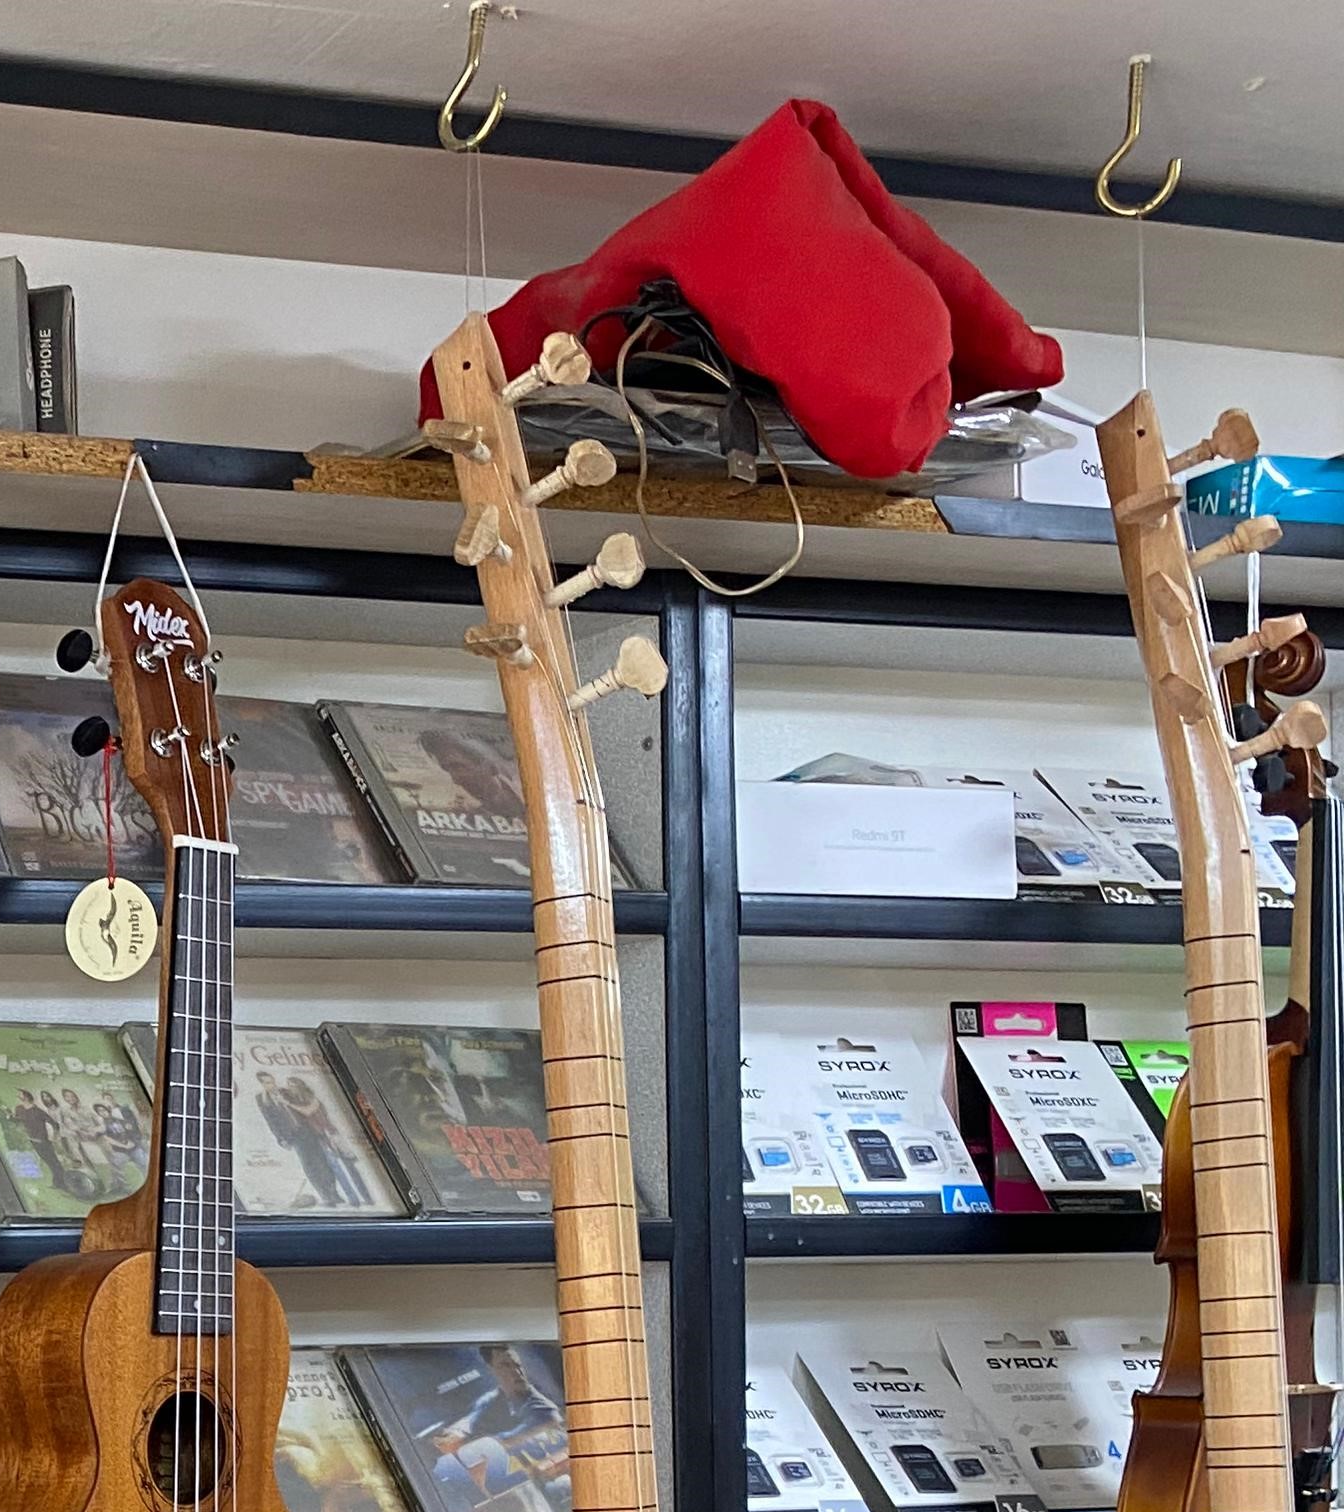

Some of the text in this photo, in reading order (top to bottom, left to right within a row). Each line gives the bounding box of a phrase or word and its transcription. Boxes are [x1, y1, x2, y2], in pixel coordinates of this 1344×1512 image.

[39, 327, 54, 420] HEADPHONE
[123, 600, 194, 647] Midex
[817, 1059, 891, 1073] SYROX
[1009, 1067, 1081, 1081] SYROX
[986, 1356, 1059, 1371] SYROX
[853, 1381, 925, 1393] SYROX
